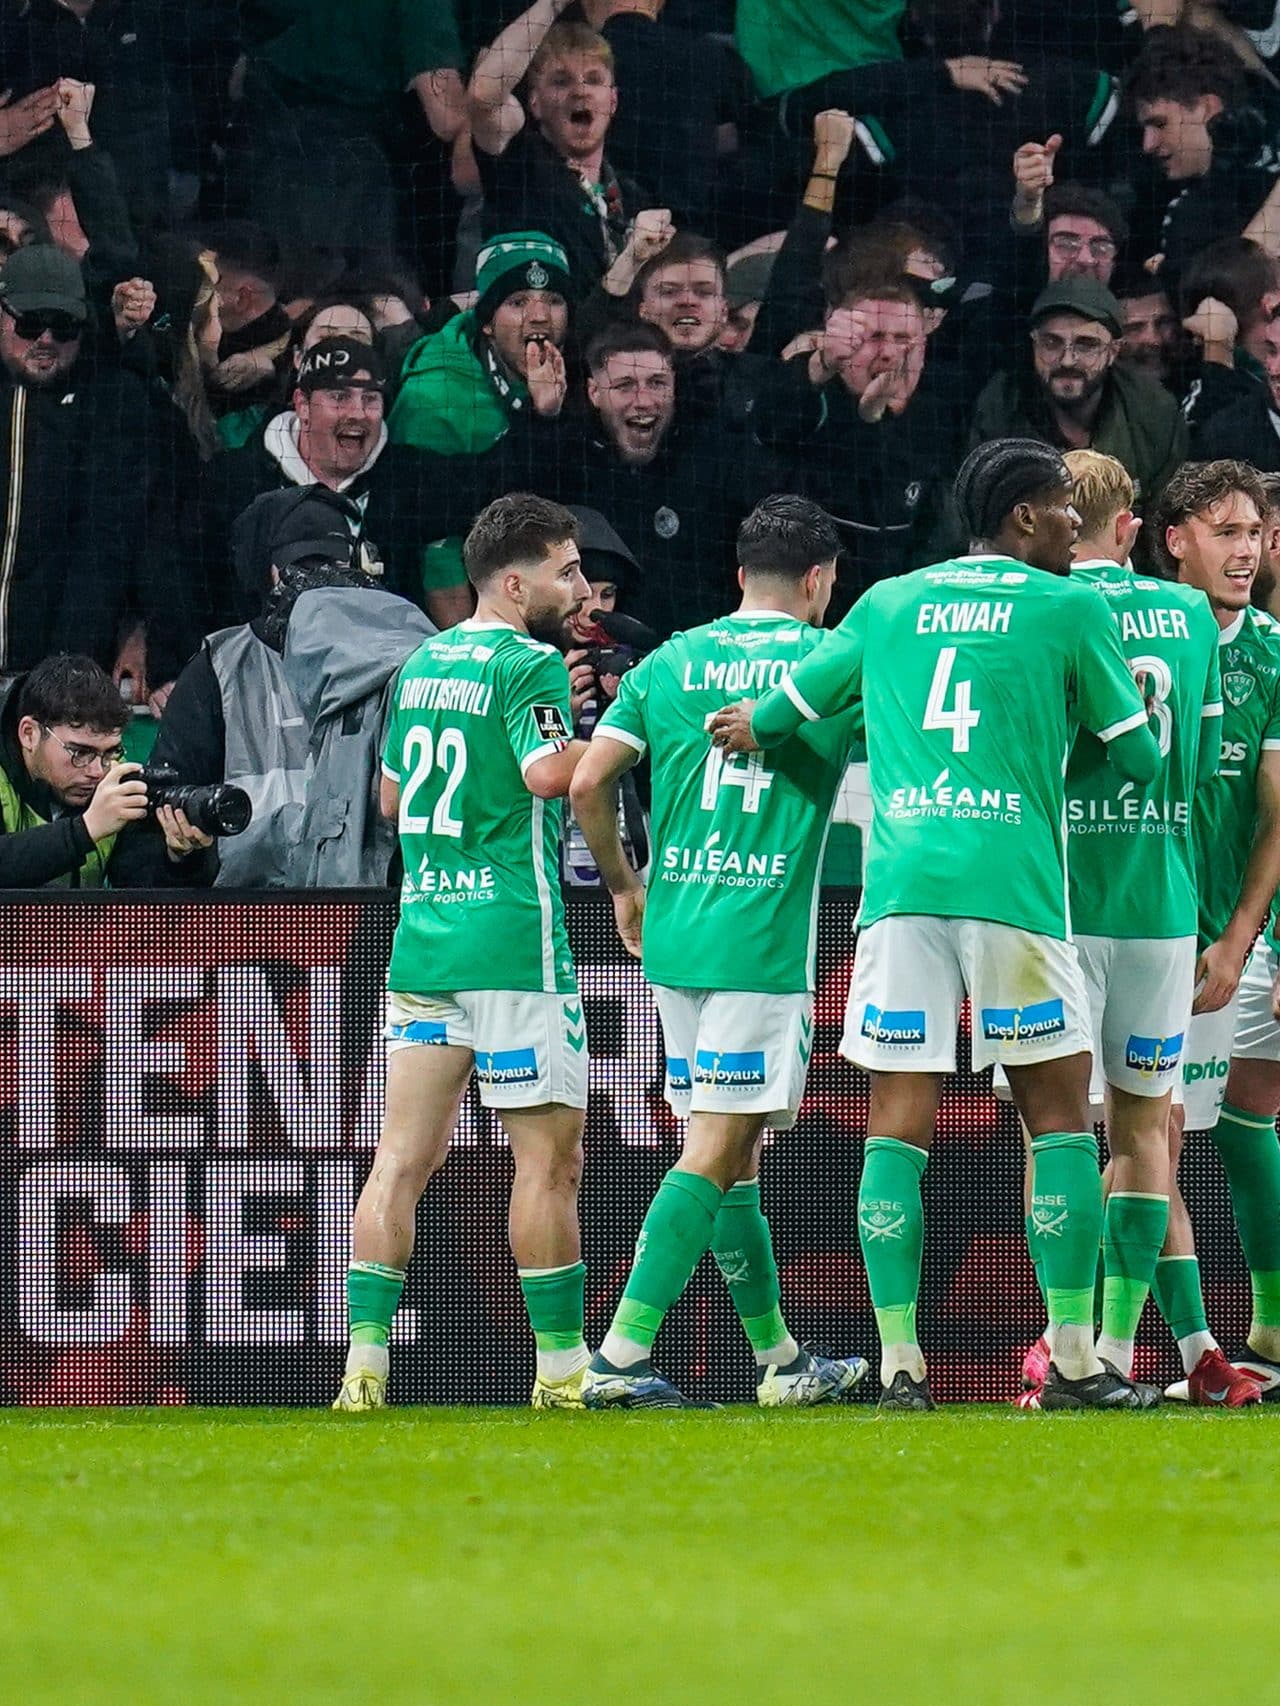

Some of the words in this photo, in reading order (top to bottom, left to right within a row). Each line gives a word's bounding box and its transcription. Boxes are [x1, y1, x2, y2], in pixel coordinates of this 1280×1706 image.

[916, 602, 1014, 635] EKWAH
[1112, 608, 1190, 642] AUER
[683, 659, 802, 692] L.MOUTO
[922, 646, 981, 753] 4
[700, 700, 776, 814] 14
[398, 725, 468, 838] 22
[952, 808, 1022, 825] ROBOTICS
[1069, 823, 1137, 835] ADAPTIVE
[717, 874, 785, 889] ROBOTICS
